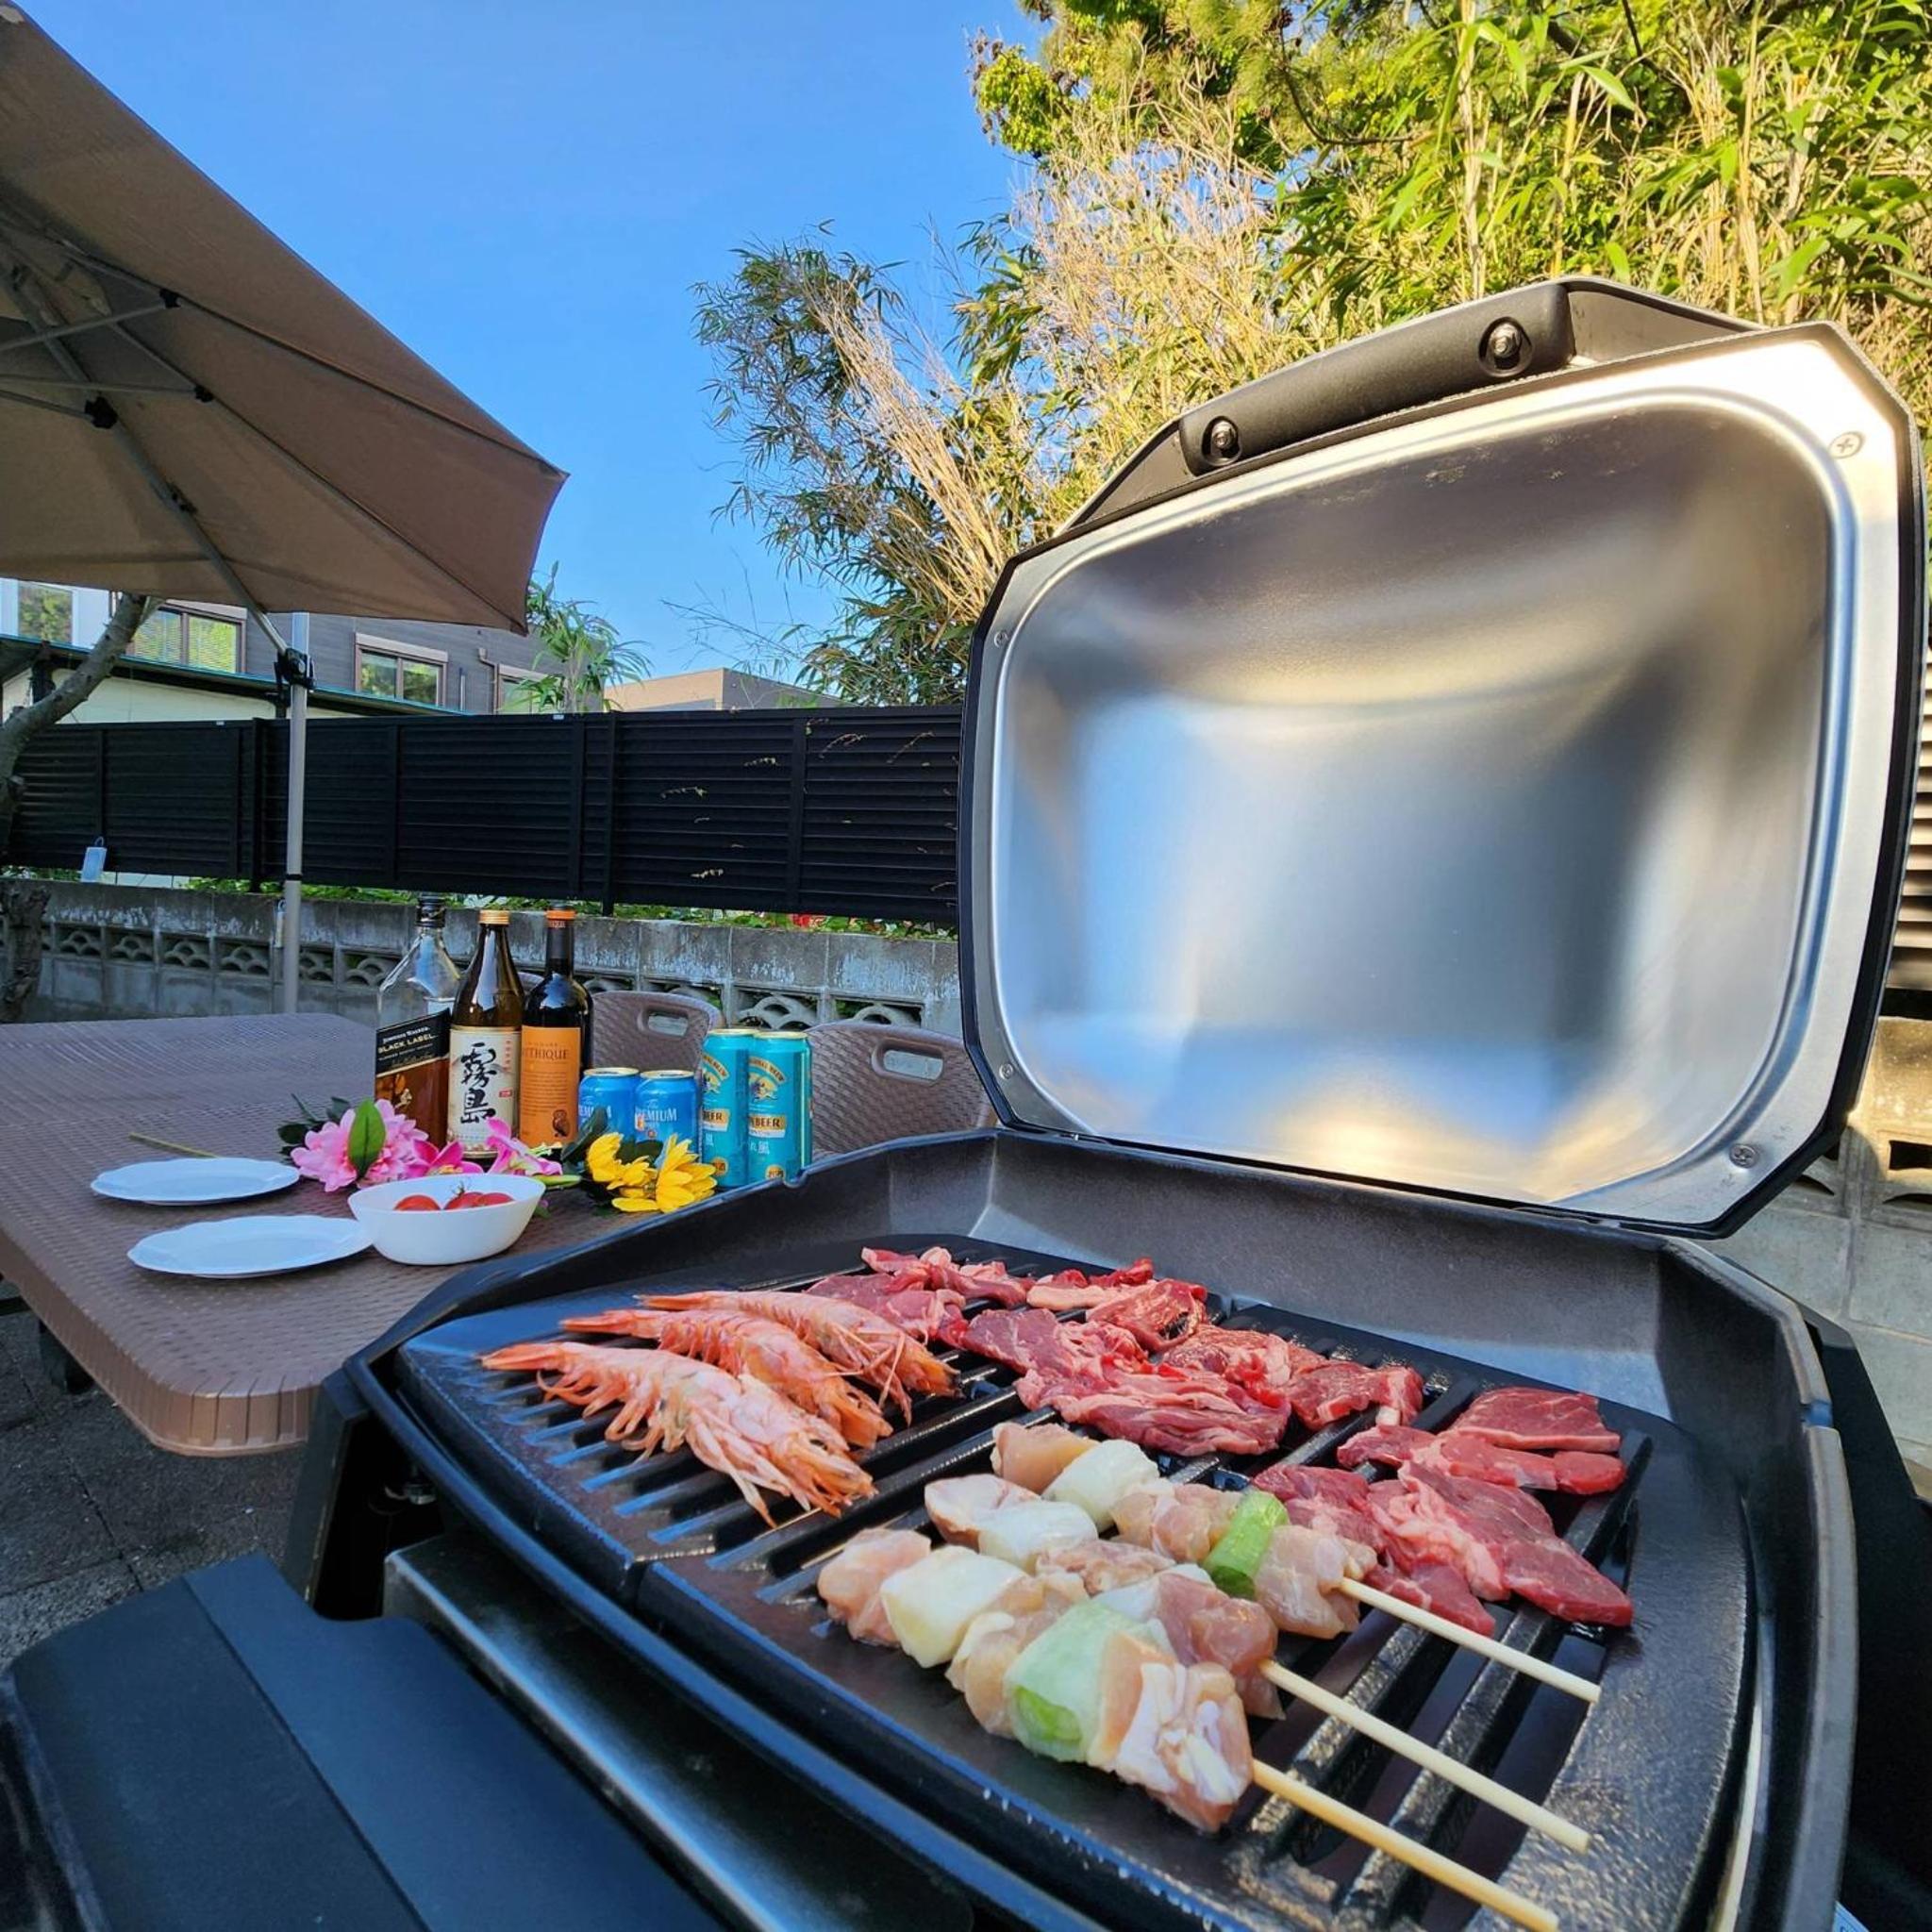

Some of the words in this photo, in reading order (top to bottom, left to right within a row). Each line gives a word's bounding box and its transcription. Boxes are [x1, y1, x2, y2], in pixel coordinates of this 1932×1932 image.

[377, 1041, 406, 1054] BLACK
[407, 1033, 434, 1044] LABEL
[460, 1041, 497, 1124] 霧島
[755, 1117, 780, 1127] BEER
